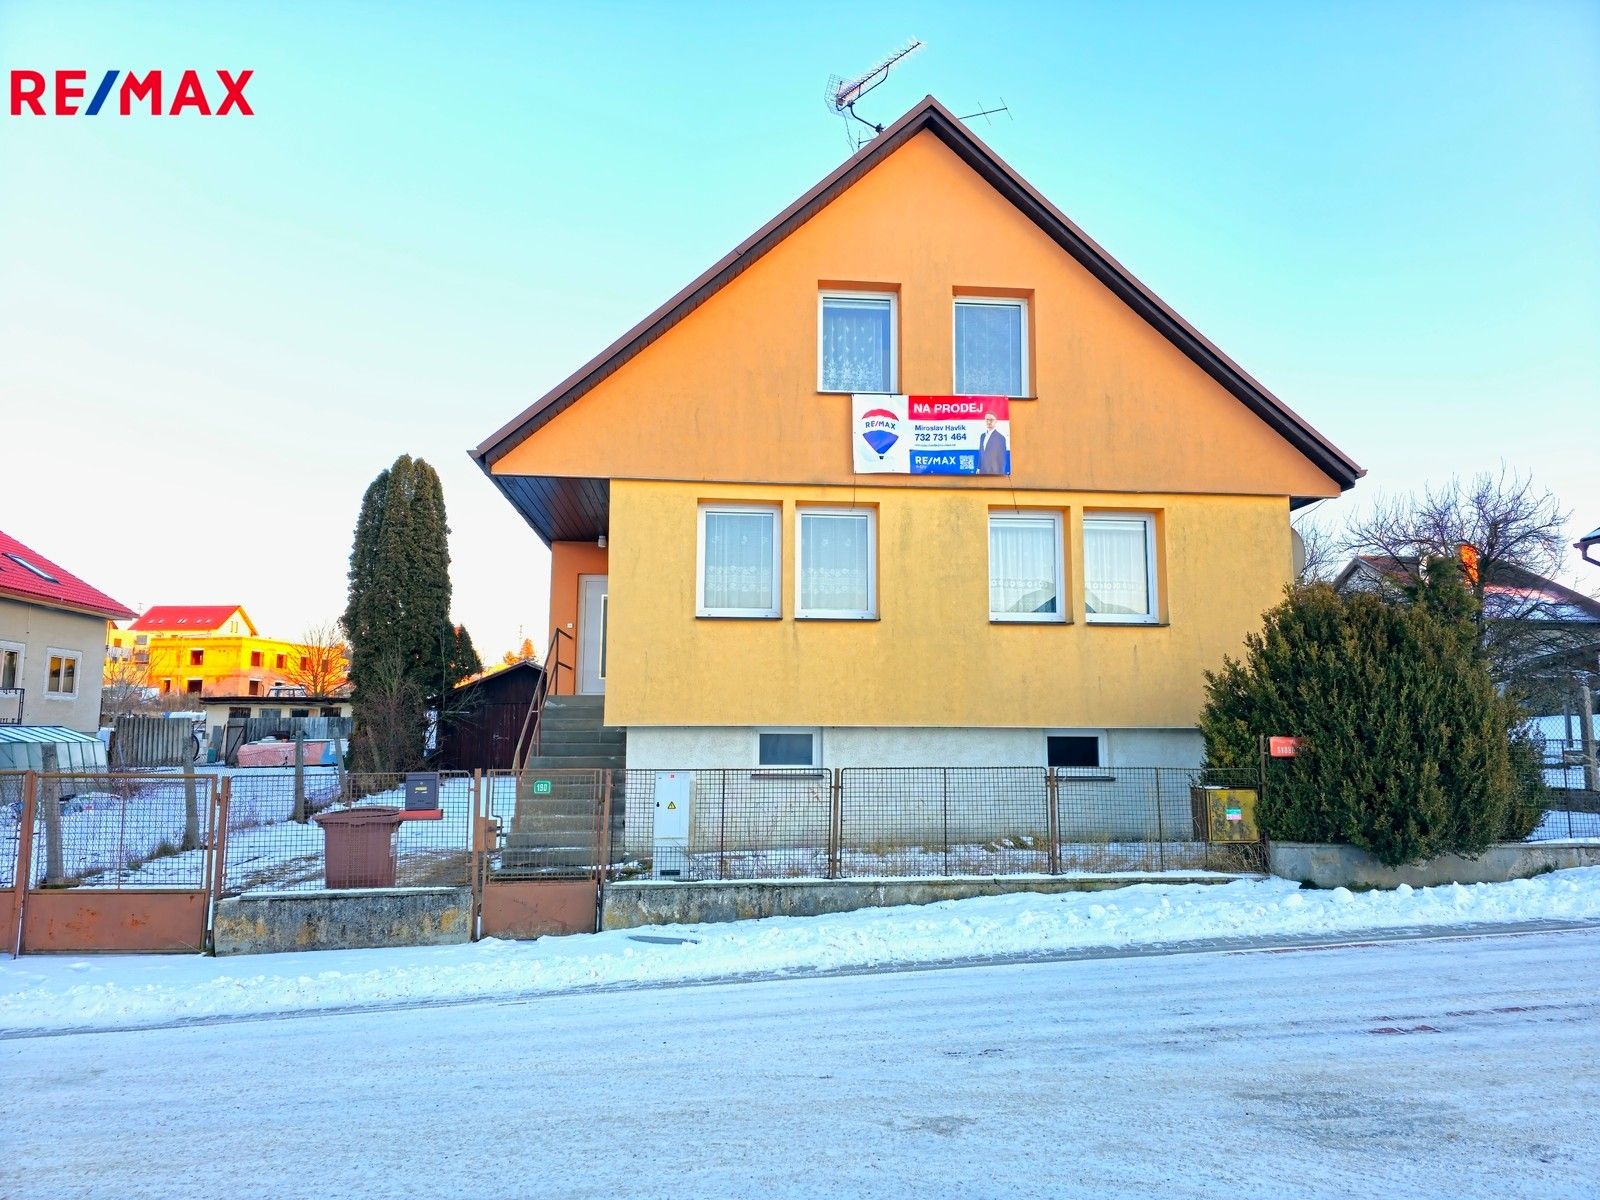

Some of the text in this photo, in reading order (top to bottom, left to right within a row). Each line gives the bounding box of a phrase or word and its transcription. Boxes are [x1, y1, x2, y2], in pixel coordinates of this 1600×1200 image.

[913, 403, 984, 413] NA PRODEJ
[865, 420, 896, 430] RE/MAX
[914, 432, 967, 441] 732 731 464
[915, 456, 956, 465] RE/MAX
[536, 783, 548, 791] 190
